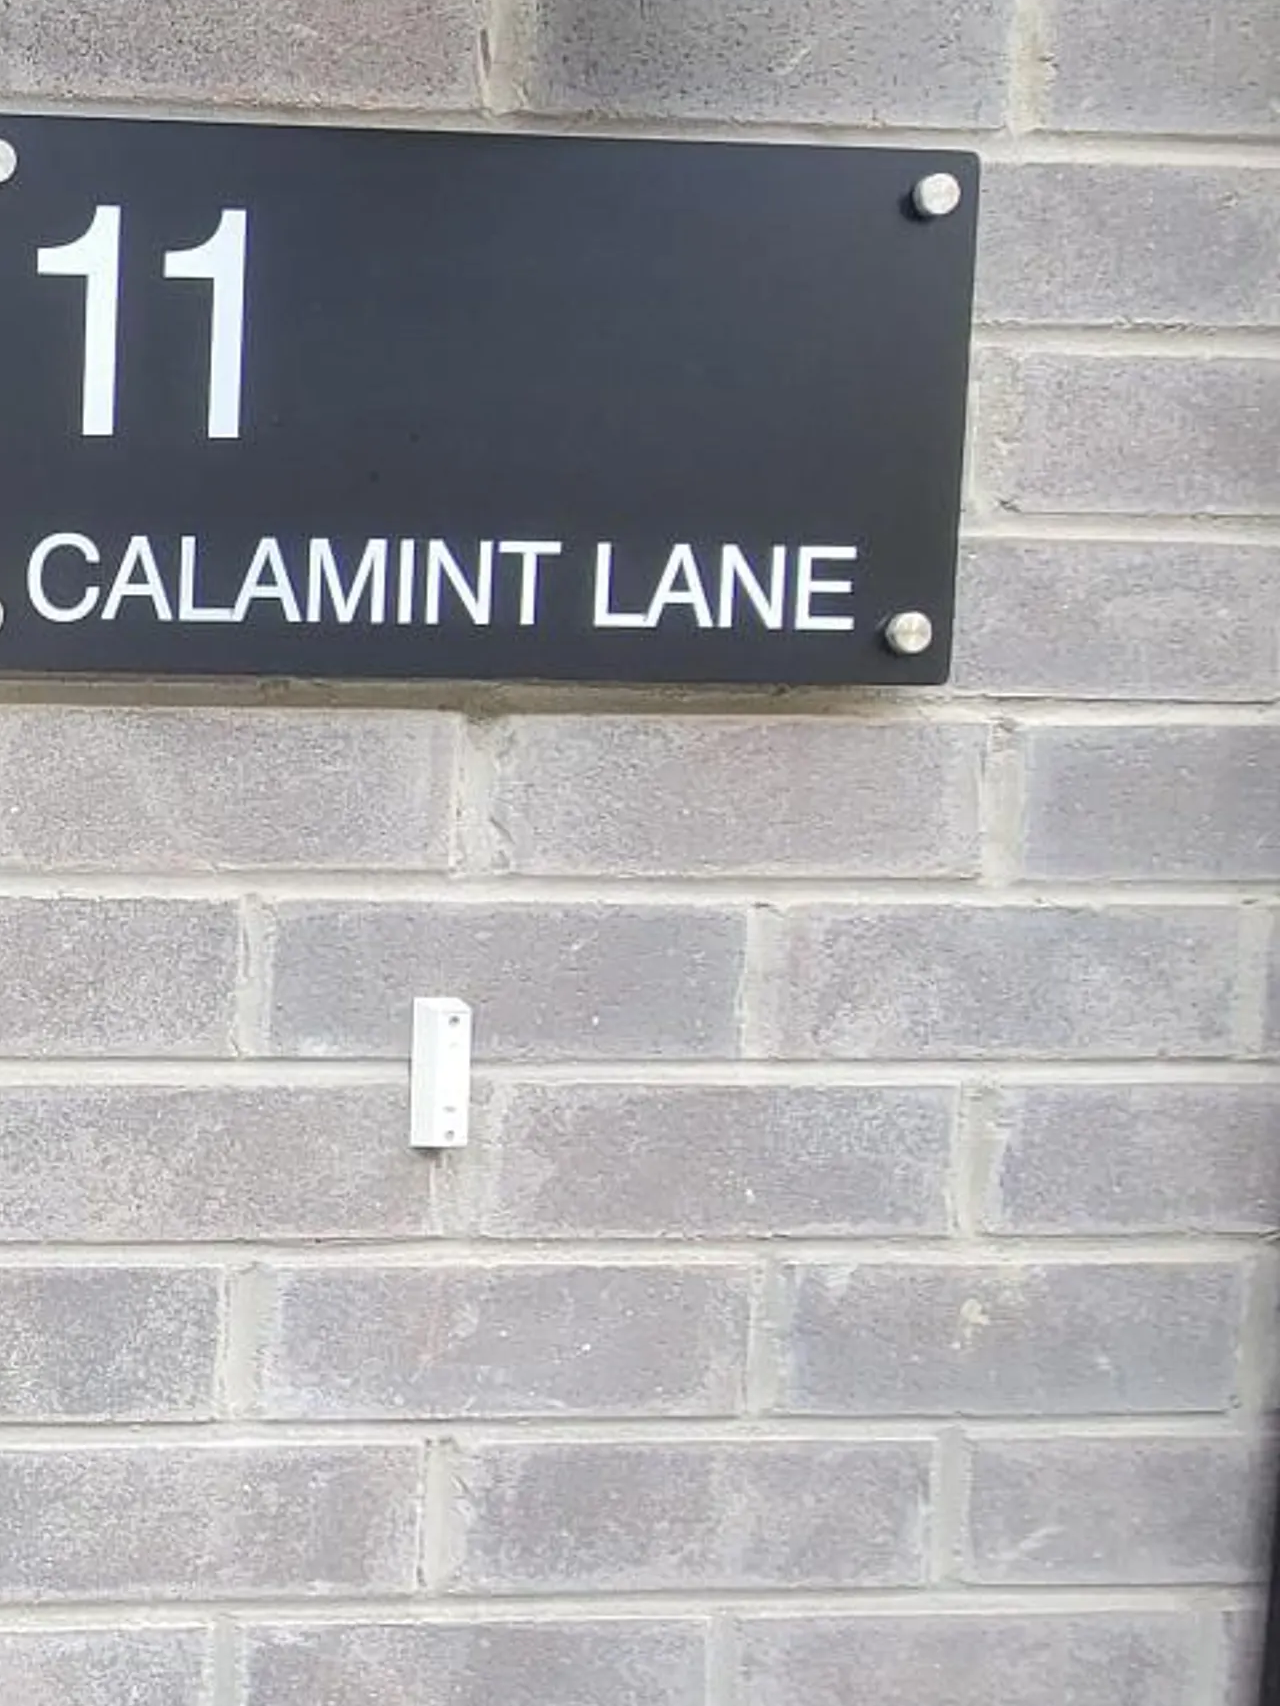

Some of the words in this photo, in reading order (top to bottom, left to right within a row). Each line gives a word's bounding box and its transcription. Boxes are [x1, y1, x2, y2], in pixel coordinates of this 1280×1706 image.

[35, 204, 248, 439] 11
[26, 532, 562, 627] CALAMINT
[592, 542, 858, 632] LANE
